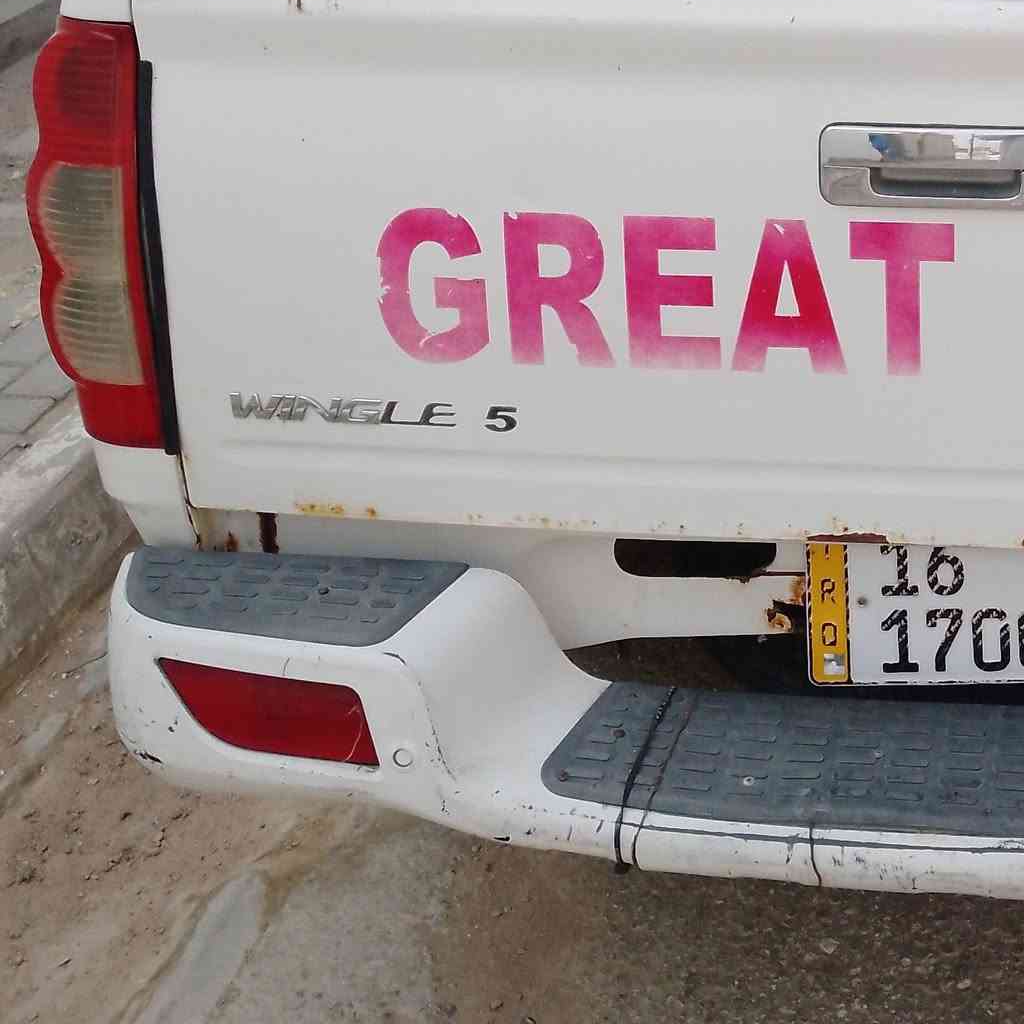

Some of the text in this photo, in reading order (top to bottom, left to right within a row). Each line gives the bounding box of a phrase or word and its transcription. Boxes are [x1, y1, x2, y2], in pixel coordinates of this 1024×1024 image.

[376, 207, 954, 375] GREAT
[229, 391, 519, 433] WINGLE 5
[881, 545, 965, 596] 16
